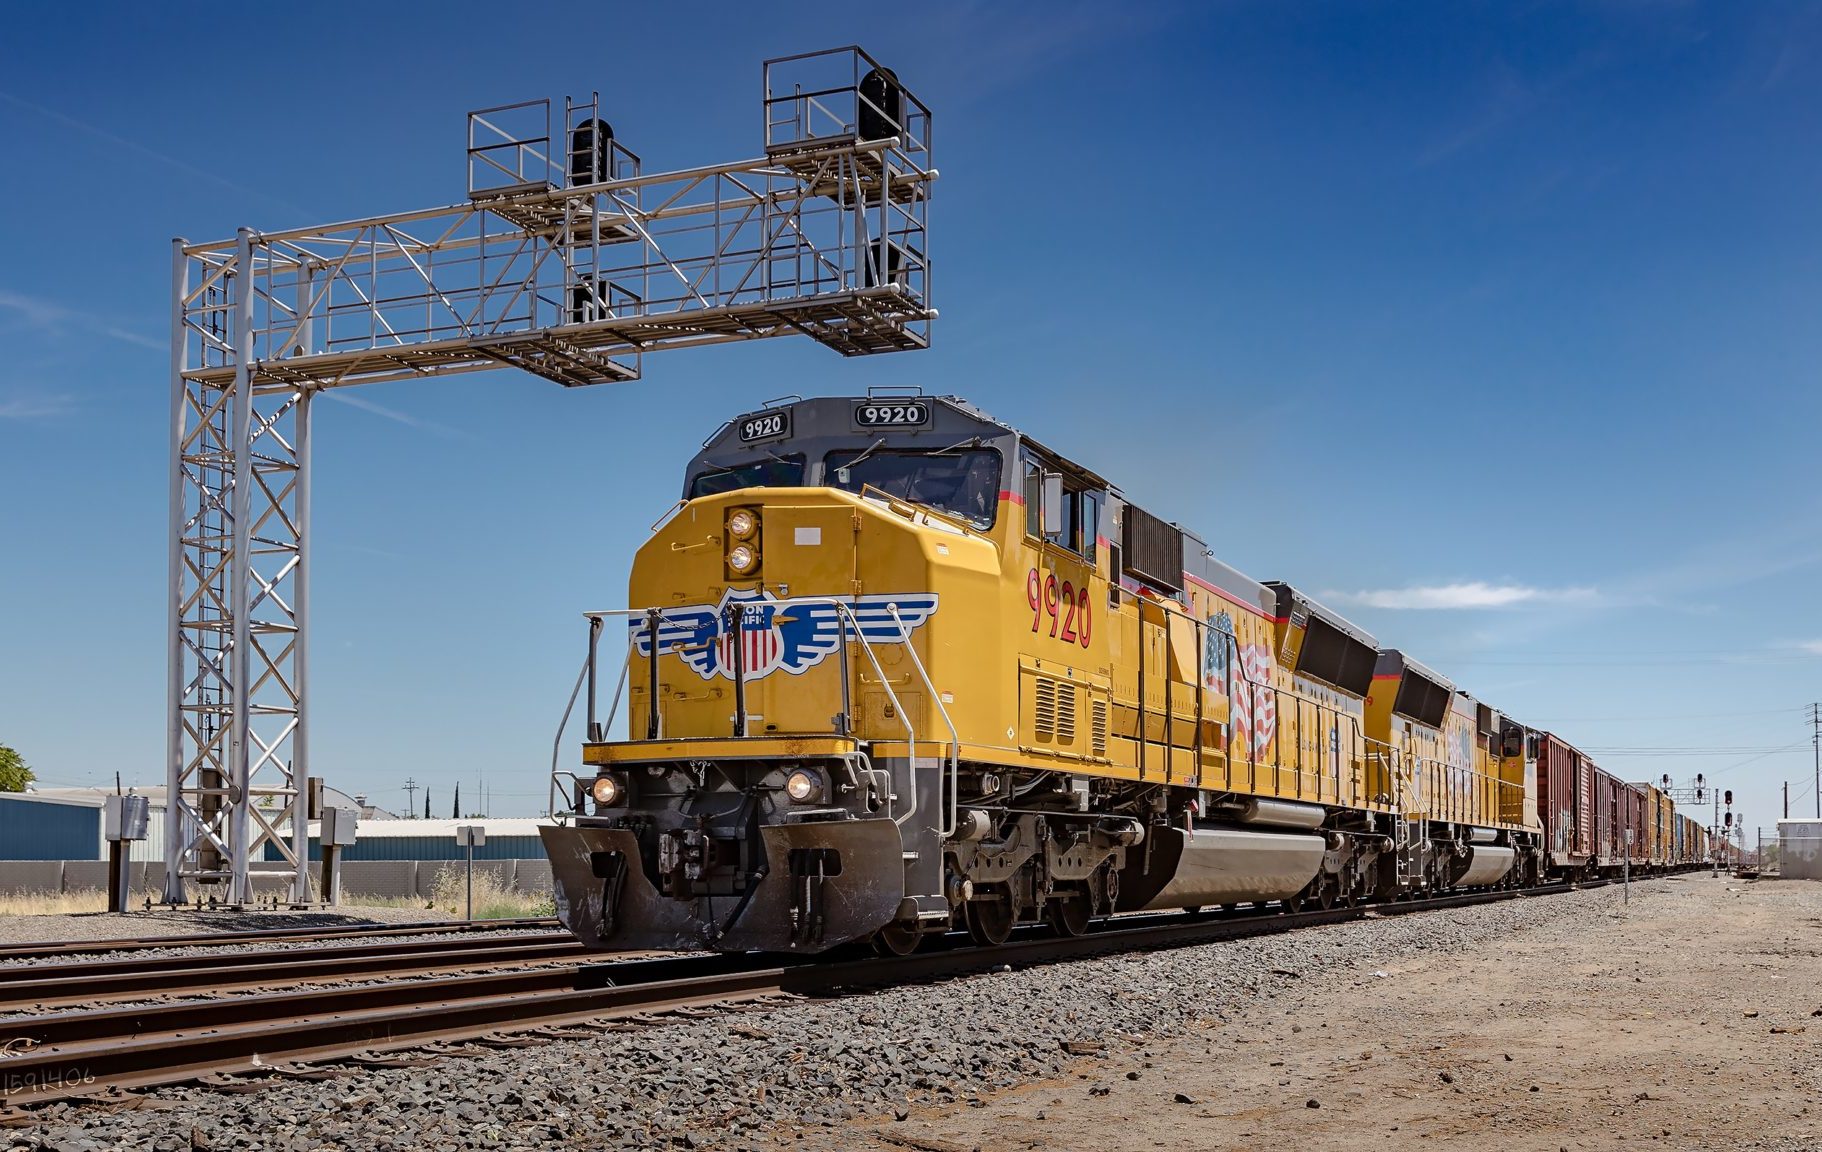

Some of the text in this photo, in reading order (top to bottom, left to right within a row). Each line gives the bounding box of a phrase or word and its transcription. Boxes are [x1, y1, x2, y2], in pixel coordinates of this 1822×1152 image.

[865, 407, 919, 423] 9920
[746, 416, 781, 438] 9920
[1027, 567, 1091, 649] 9920
[742, 615, 764, 625] IFIC
[4, 1067, 96, 1096] 1591406
